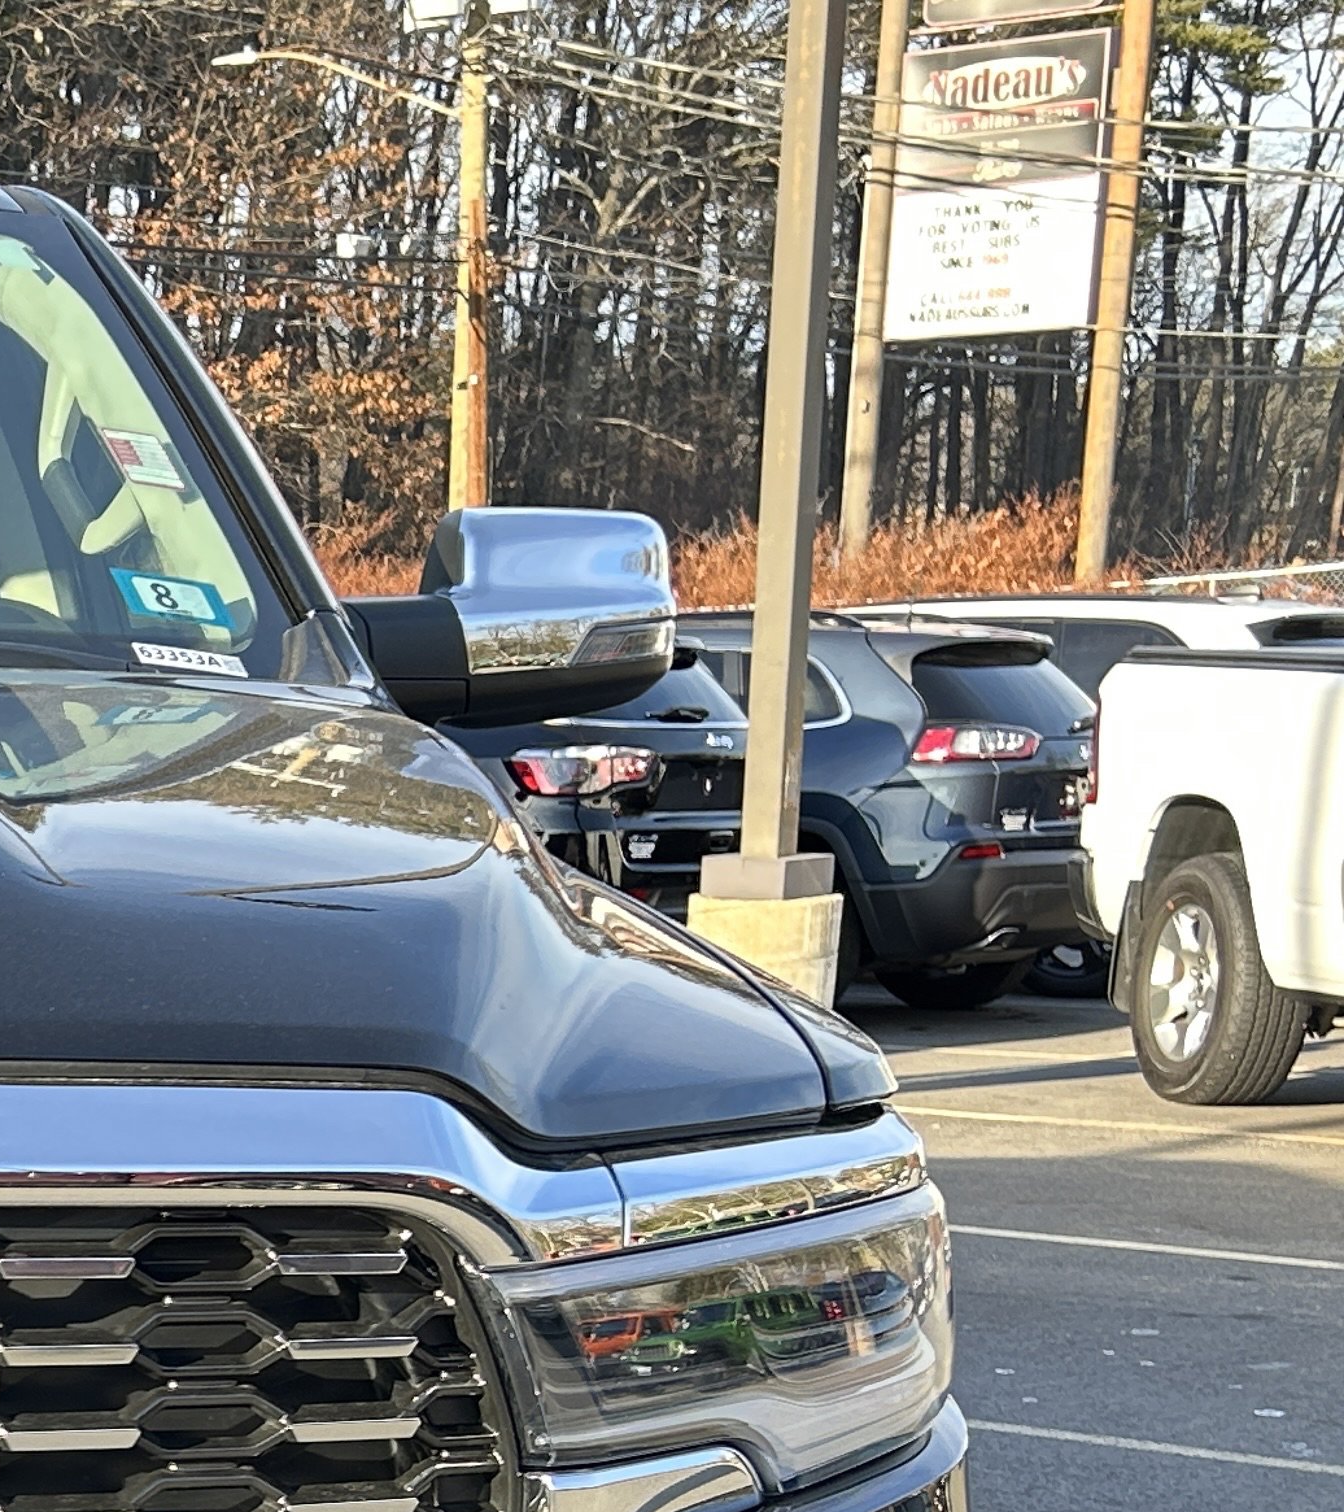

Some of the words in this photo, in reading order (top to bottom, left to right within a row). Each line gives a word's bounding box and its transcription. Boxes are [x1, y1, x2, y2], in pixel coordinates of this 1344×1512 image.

[929, 56, 1082, 106] Nadeau's
[934, 204, 981, 218] THANK
[1003, 200, 1034, 213] YOU
[919, 223, 947, 238] FOR
[961, 219, 1011, 234] VOTING
[150, 582, 179, 610] 8
[138, 645, 223, 668] 63353A
